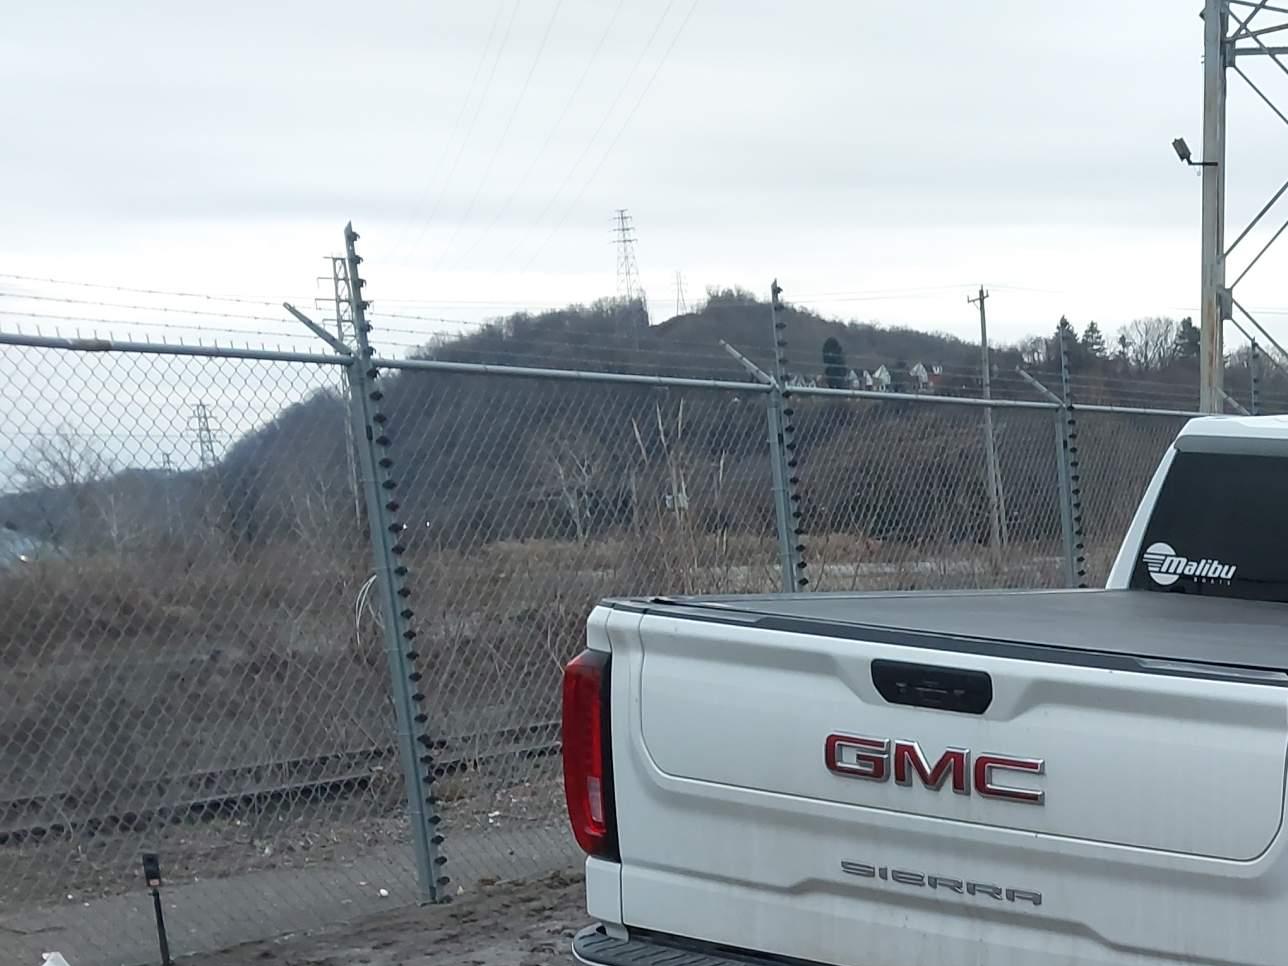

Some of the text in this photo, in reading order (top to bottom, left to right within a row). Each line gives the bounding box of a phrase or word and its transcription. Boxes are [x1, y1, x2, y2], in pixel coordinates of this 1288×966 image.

[1160, 556, 1237, 579] Malibu
[824, 730, 1046, 806] GMC
[840, 860, 1043, 906] SIERRA
